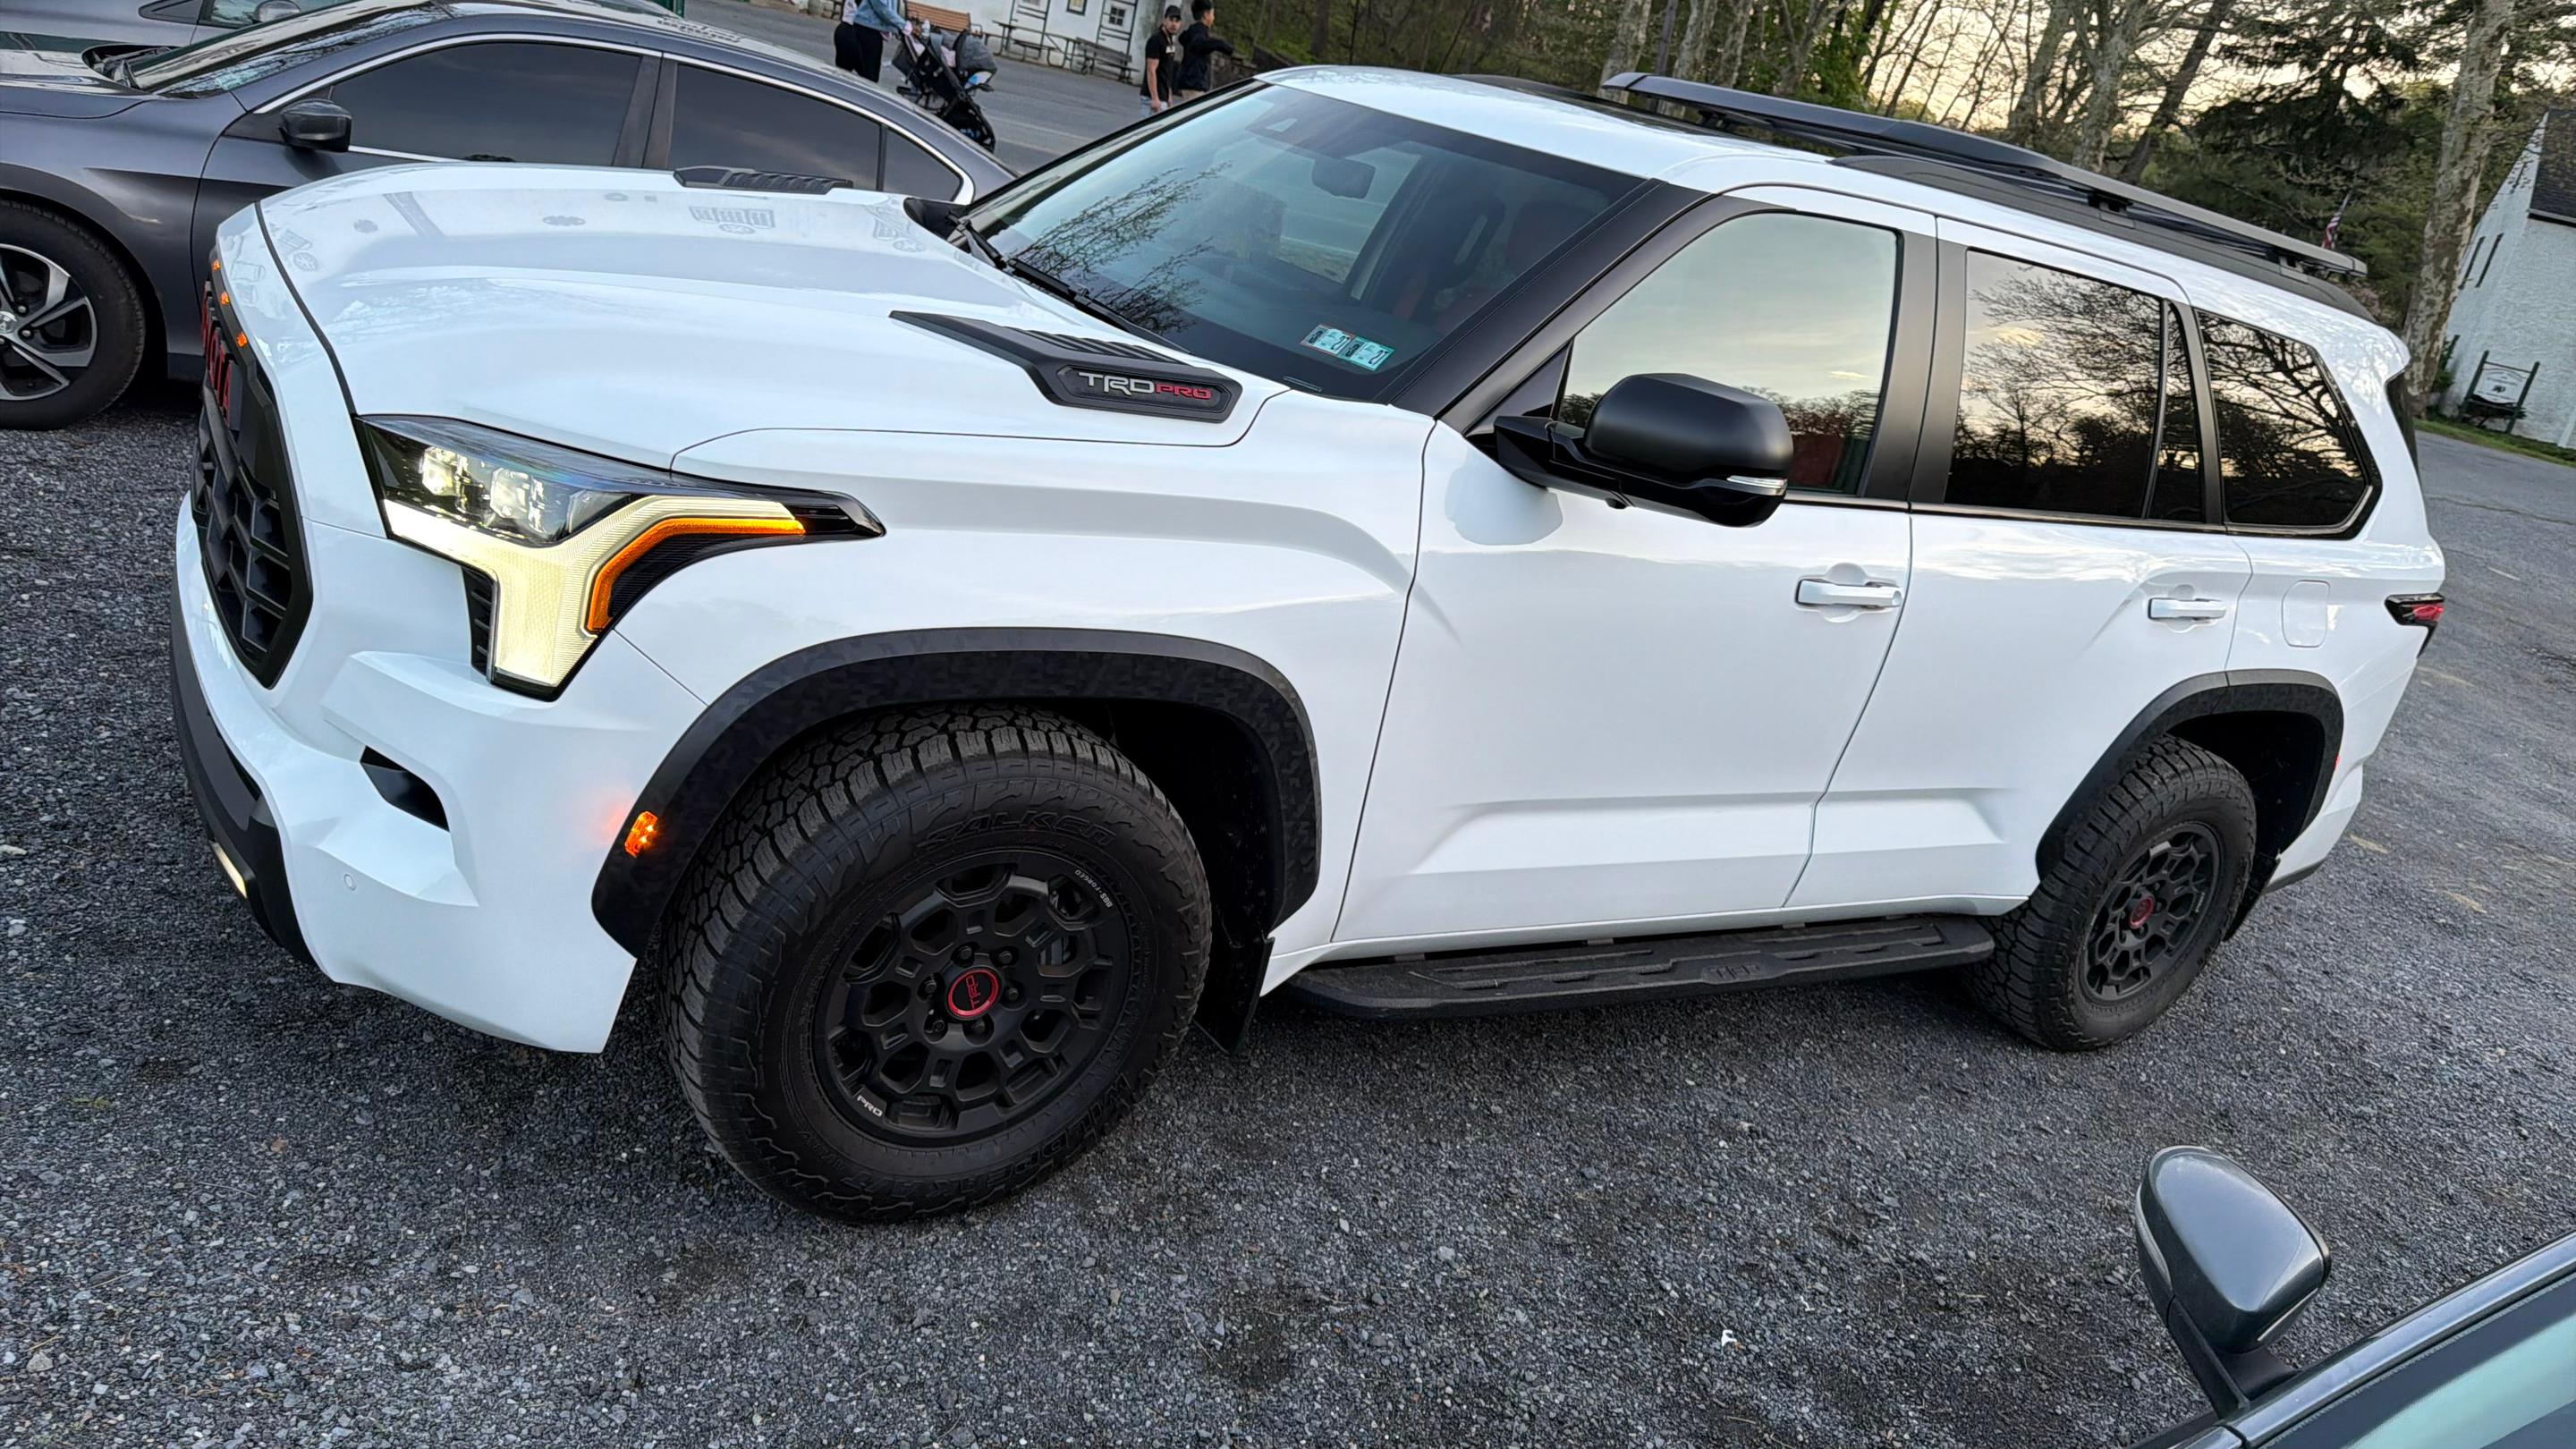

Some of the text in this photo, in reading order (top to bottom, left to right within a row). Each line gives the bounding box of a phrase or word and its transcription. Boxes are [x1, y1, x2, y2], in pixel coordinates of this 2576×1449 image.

[1078, 371, 1213, 400] TRD PRO
[966, 974, 980, 1010] TRD
[857, 1094, 884, 1117] PRO
